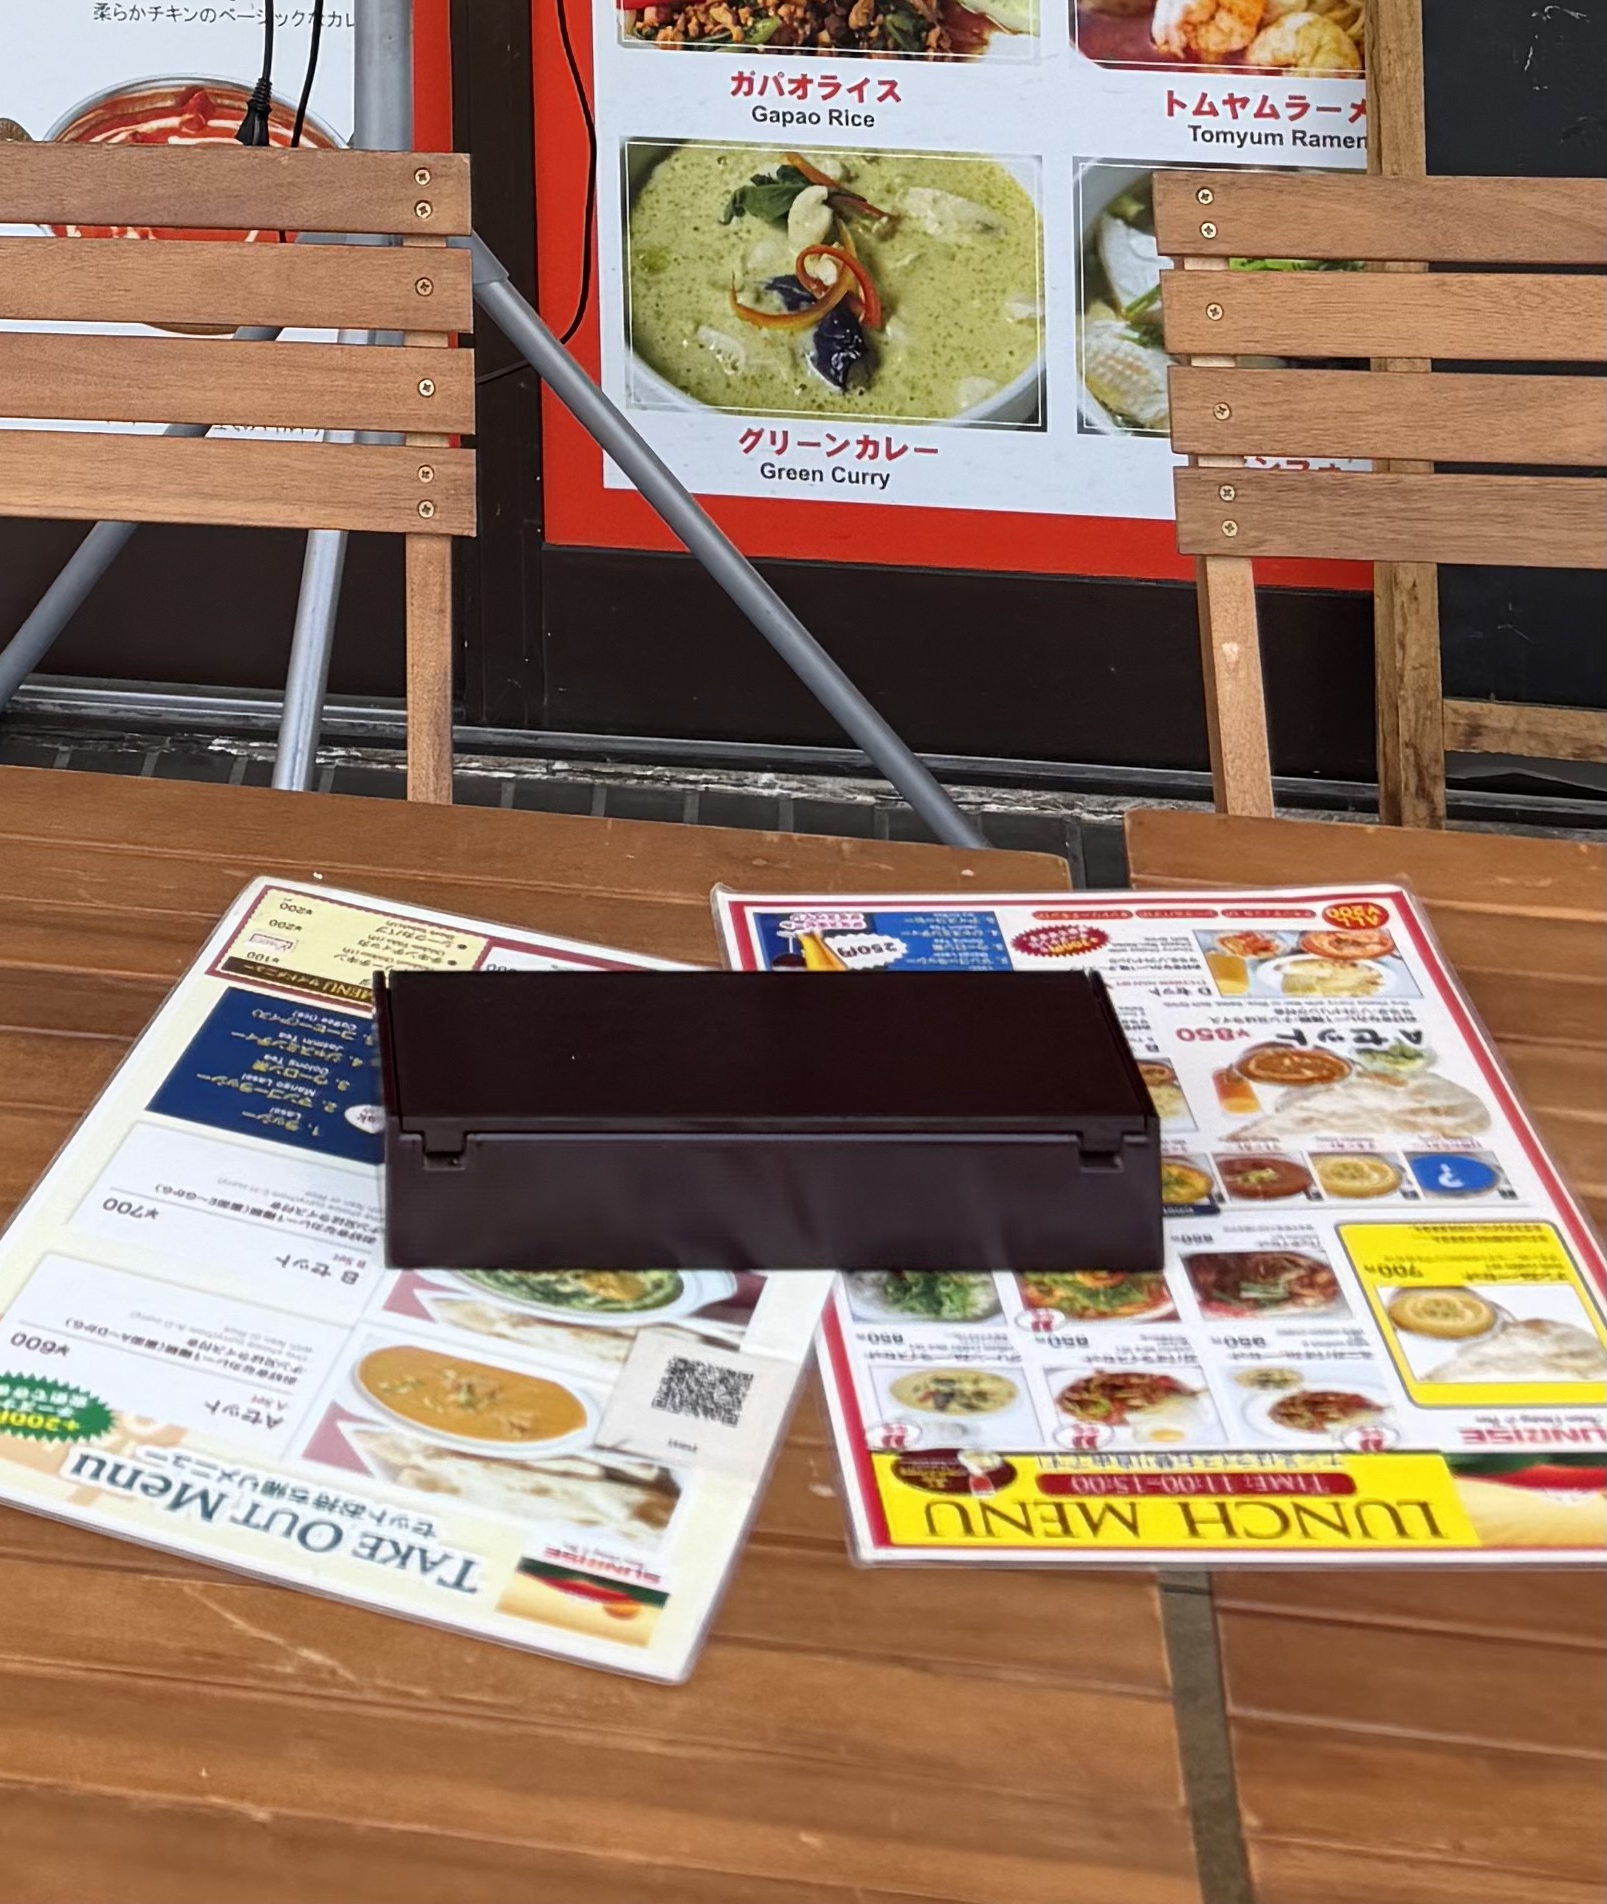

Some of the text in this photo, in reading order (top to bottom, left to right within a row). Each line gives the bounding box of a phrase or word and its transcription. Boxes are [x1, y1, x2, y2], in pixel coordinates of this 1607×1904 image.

[730, 70, 904, 105] ガパオライス
[750, 104, 875, 130] Gapao Rice
[1187, 124, 1368, 150] Tomyum Ramen
[738, 426, 940, 462] グリーンカレー
[759, 462, 891, 490] Green Curry
[67, 1452, 479, 1596] TAKE OUT Menu
[921, 1497, 1452, 1541] LUNCH MENU
